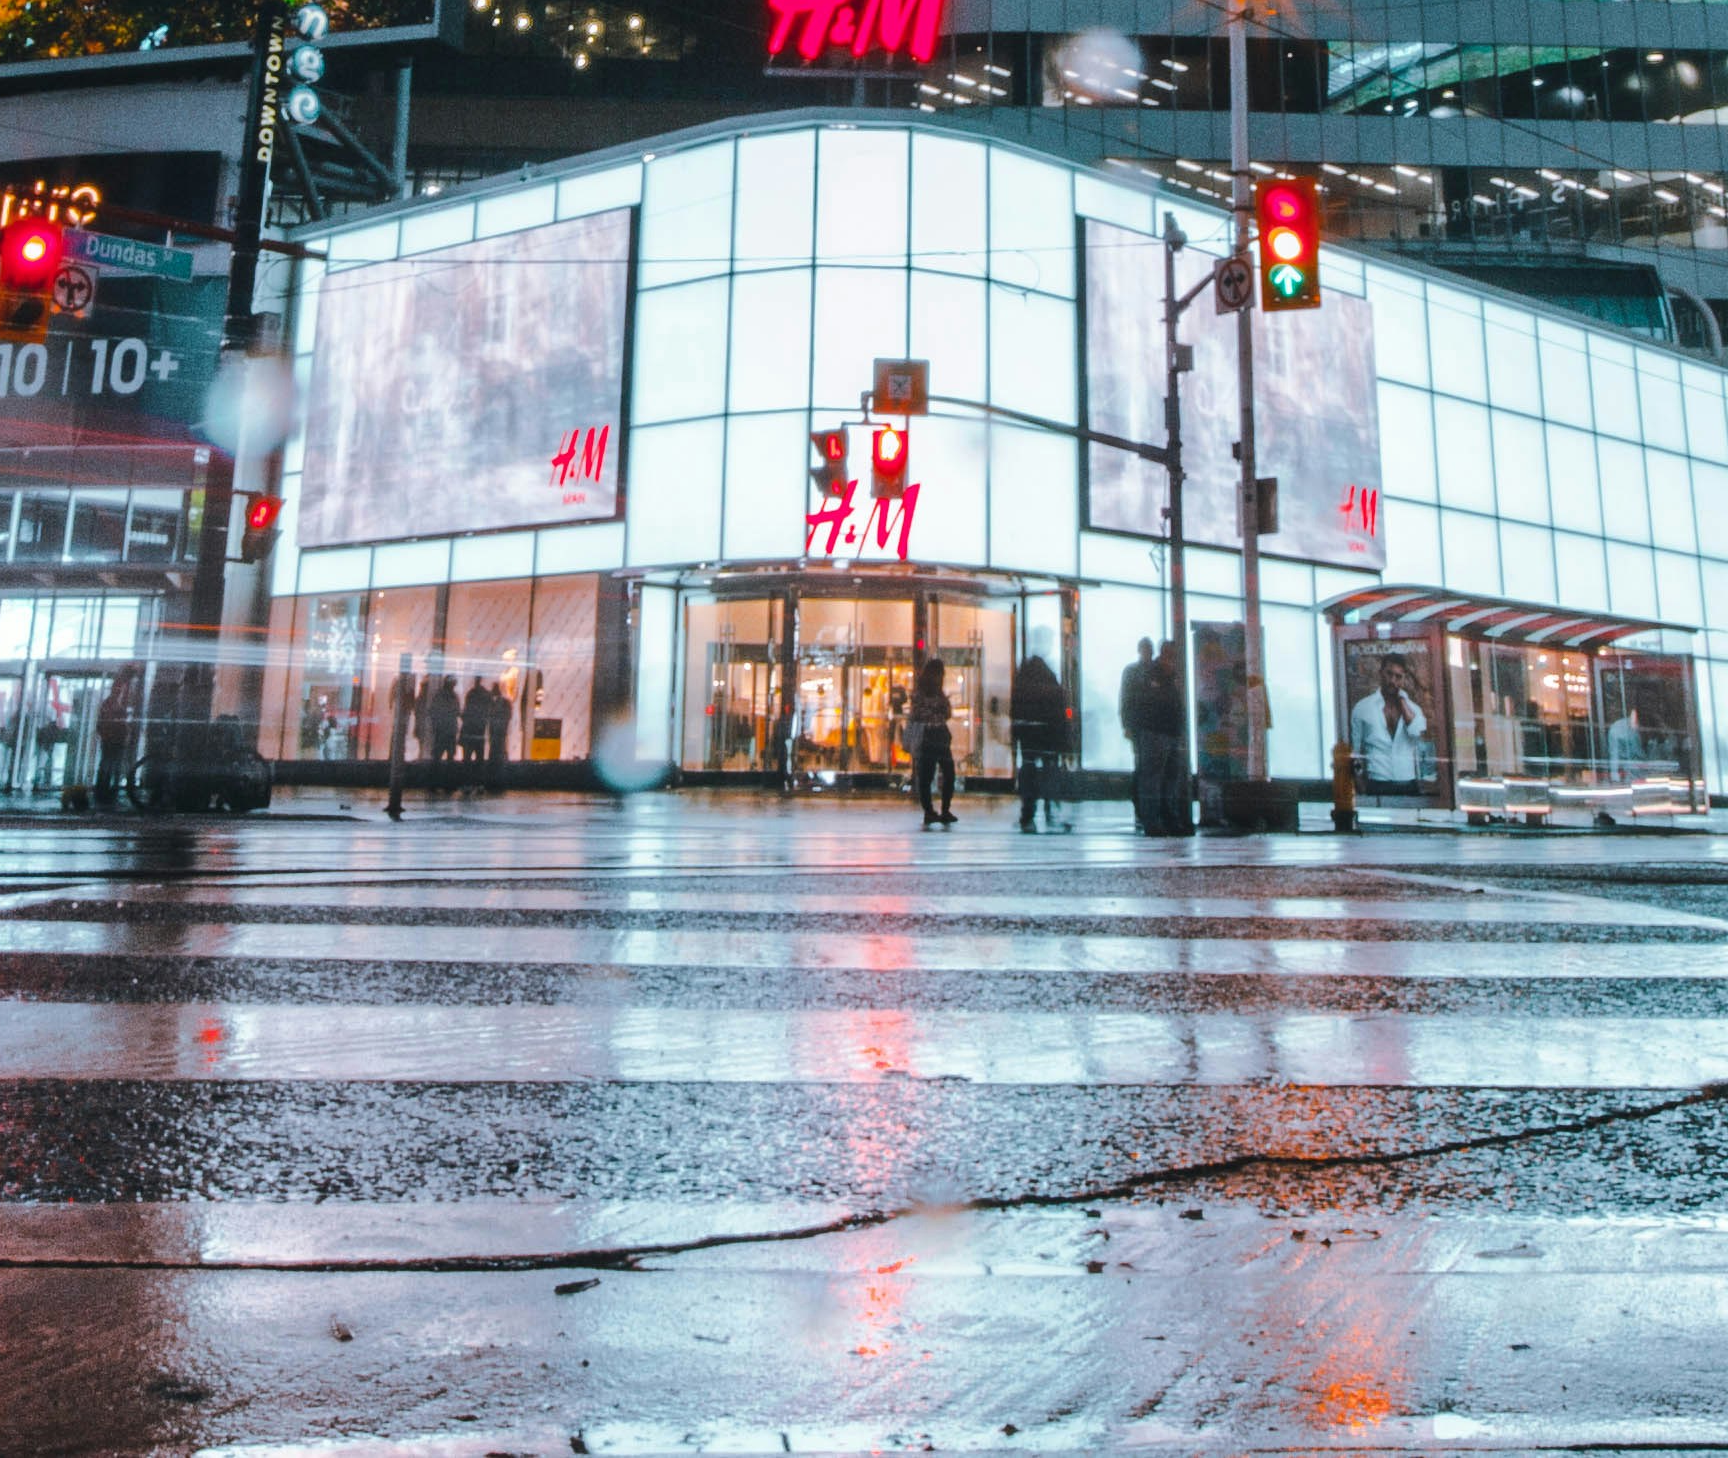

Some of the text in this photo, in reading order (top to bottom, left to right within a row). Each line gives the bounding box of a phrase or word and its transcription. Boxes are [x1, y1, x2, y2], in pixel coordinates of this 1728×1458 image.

[257, 15, 286, 162] DOWNTOWN
[86, 235, 157, 268] Dundas
[91, 338, 180, 396] 10+
[805, 479, 921, 562] H&M
[1338, 484, 1378, 540] HM
